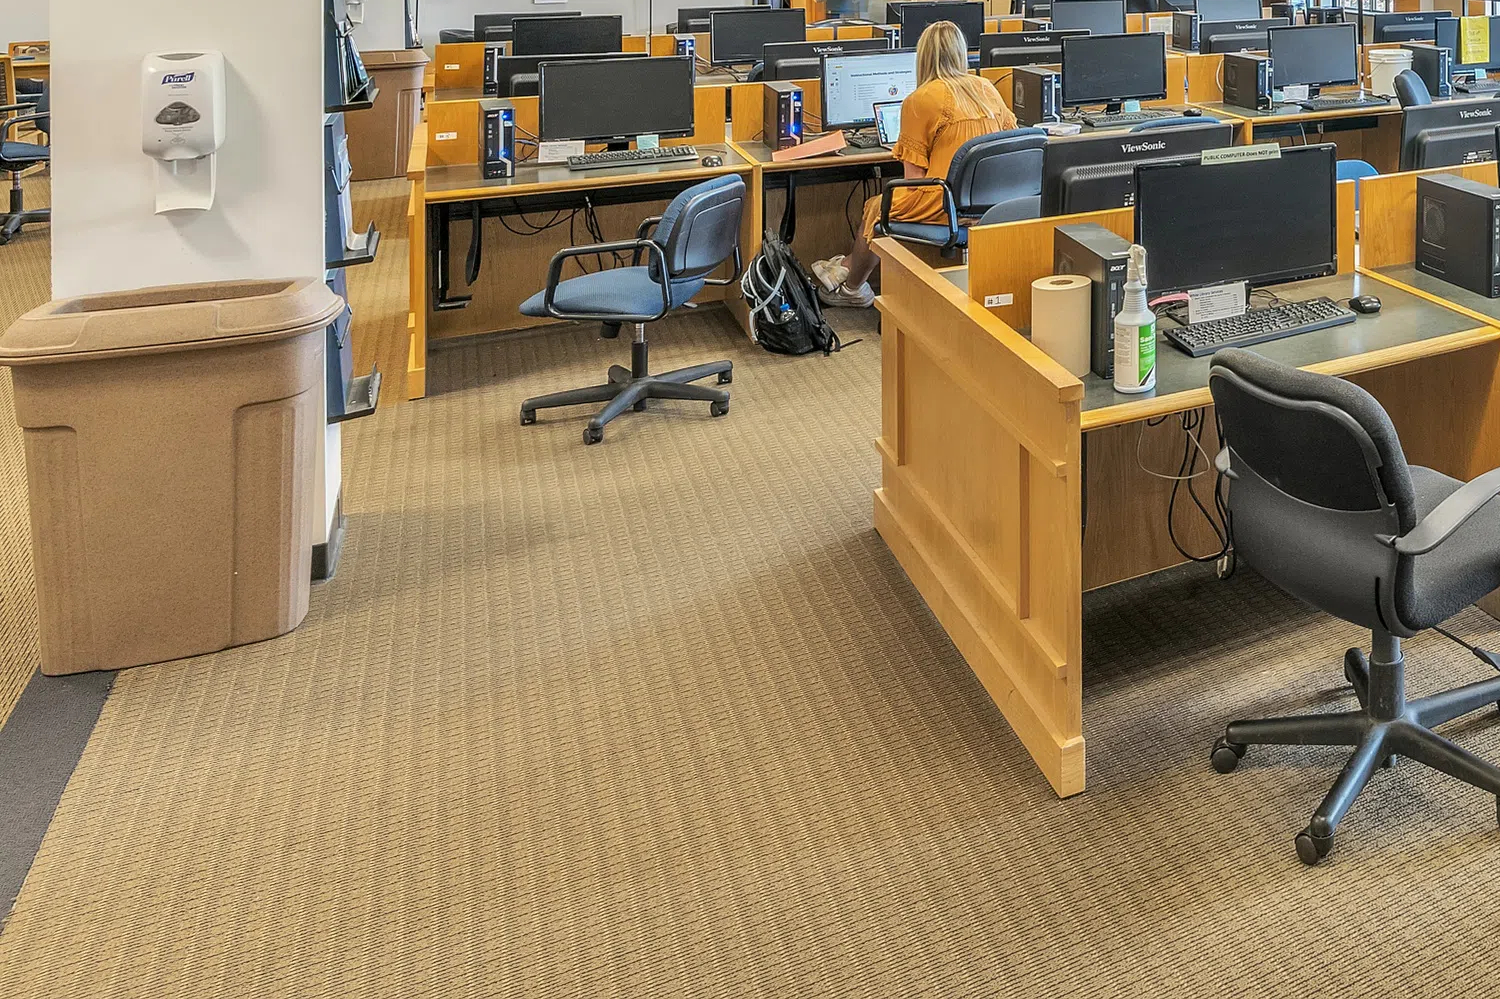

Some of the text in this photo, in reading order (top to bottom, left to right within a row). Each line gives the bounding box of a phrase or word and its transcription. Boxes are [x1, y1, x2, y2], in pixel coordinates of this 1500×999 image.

[813, 46, 844, 54] ViewSonic
[1459, 108, 1493, 119] ViewSonic
[1120, 140, 1166, 153] ViewSonic
[1110, 264, 1126, 272] acer
